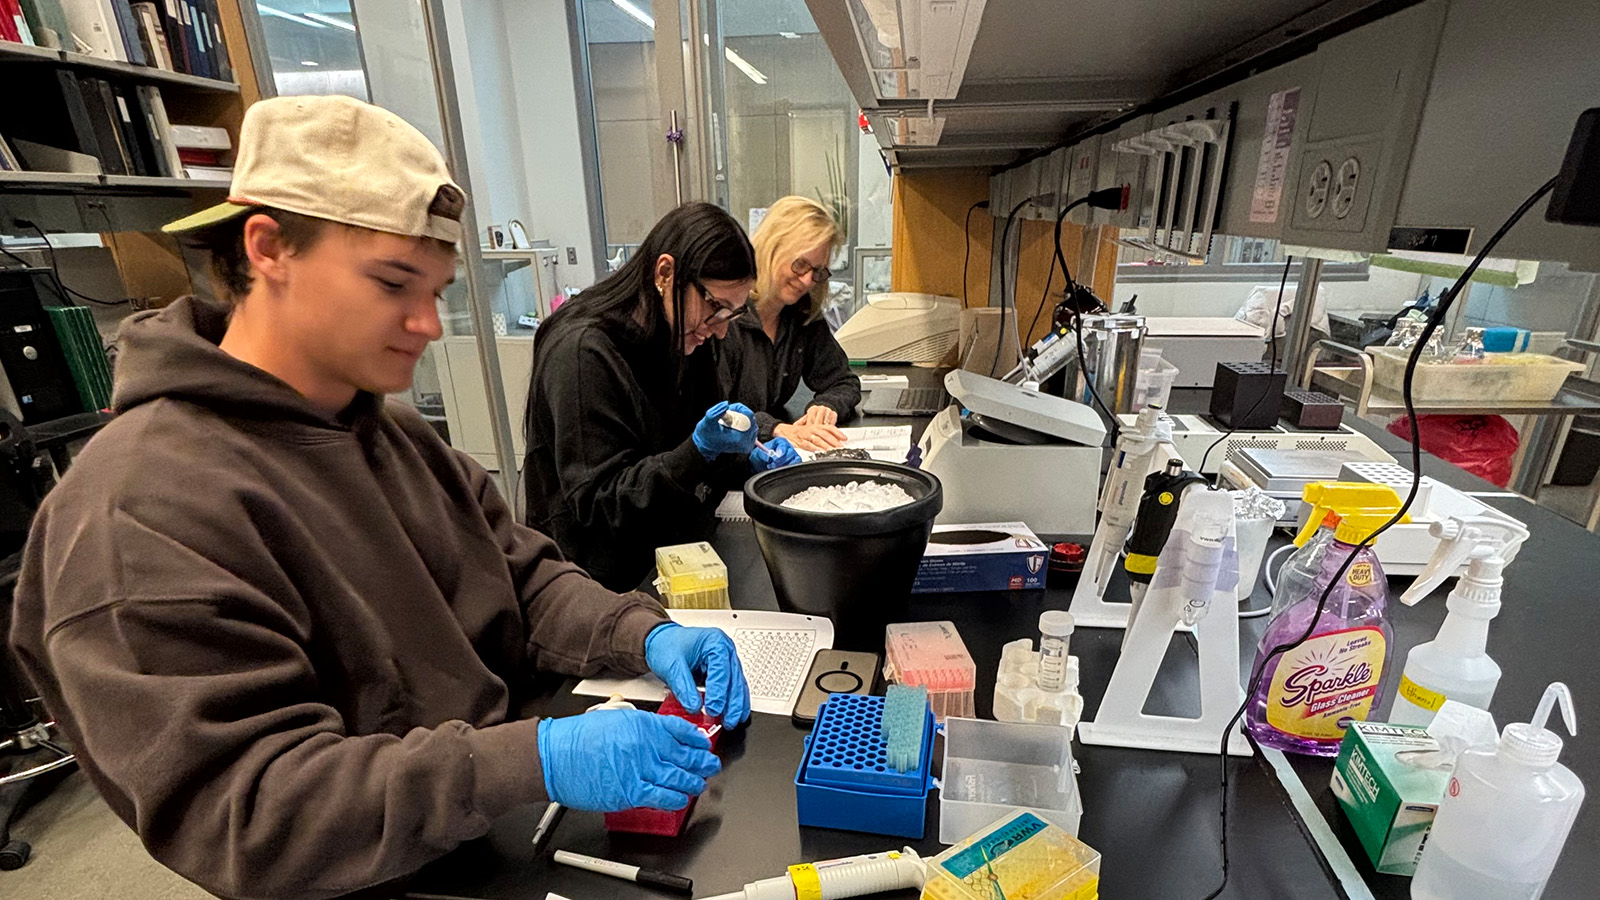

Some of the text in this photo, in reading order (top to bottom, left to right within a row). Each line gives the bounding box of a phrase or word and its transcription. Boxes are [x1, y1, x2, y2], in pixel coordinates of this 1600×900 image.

[1346, 636, 1368, 646] Leaves
[1349, 640, 1371, 652] Streaks
[1280, 662, 1372, 707] Sparkle
[1310, 688, 1370, 712] Glass Cleaner
[1350, 749, 1380, 797] KIMTECH
[983, 818, 1030, 849] INTERNATIONAL
[1012, 822, 1041, 841] VWR
